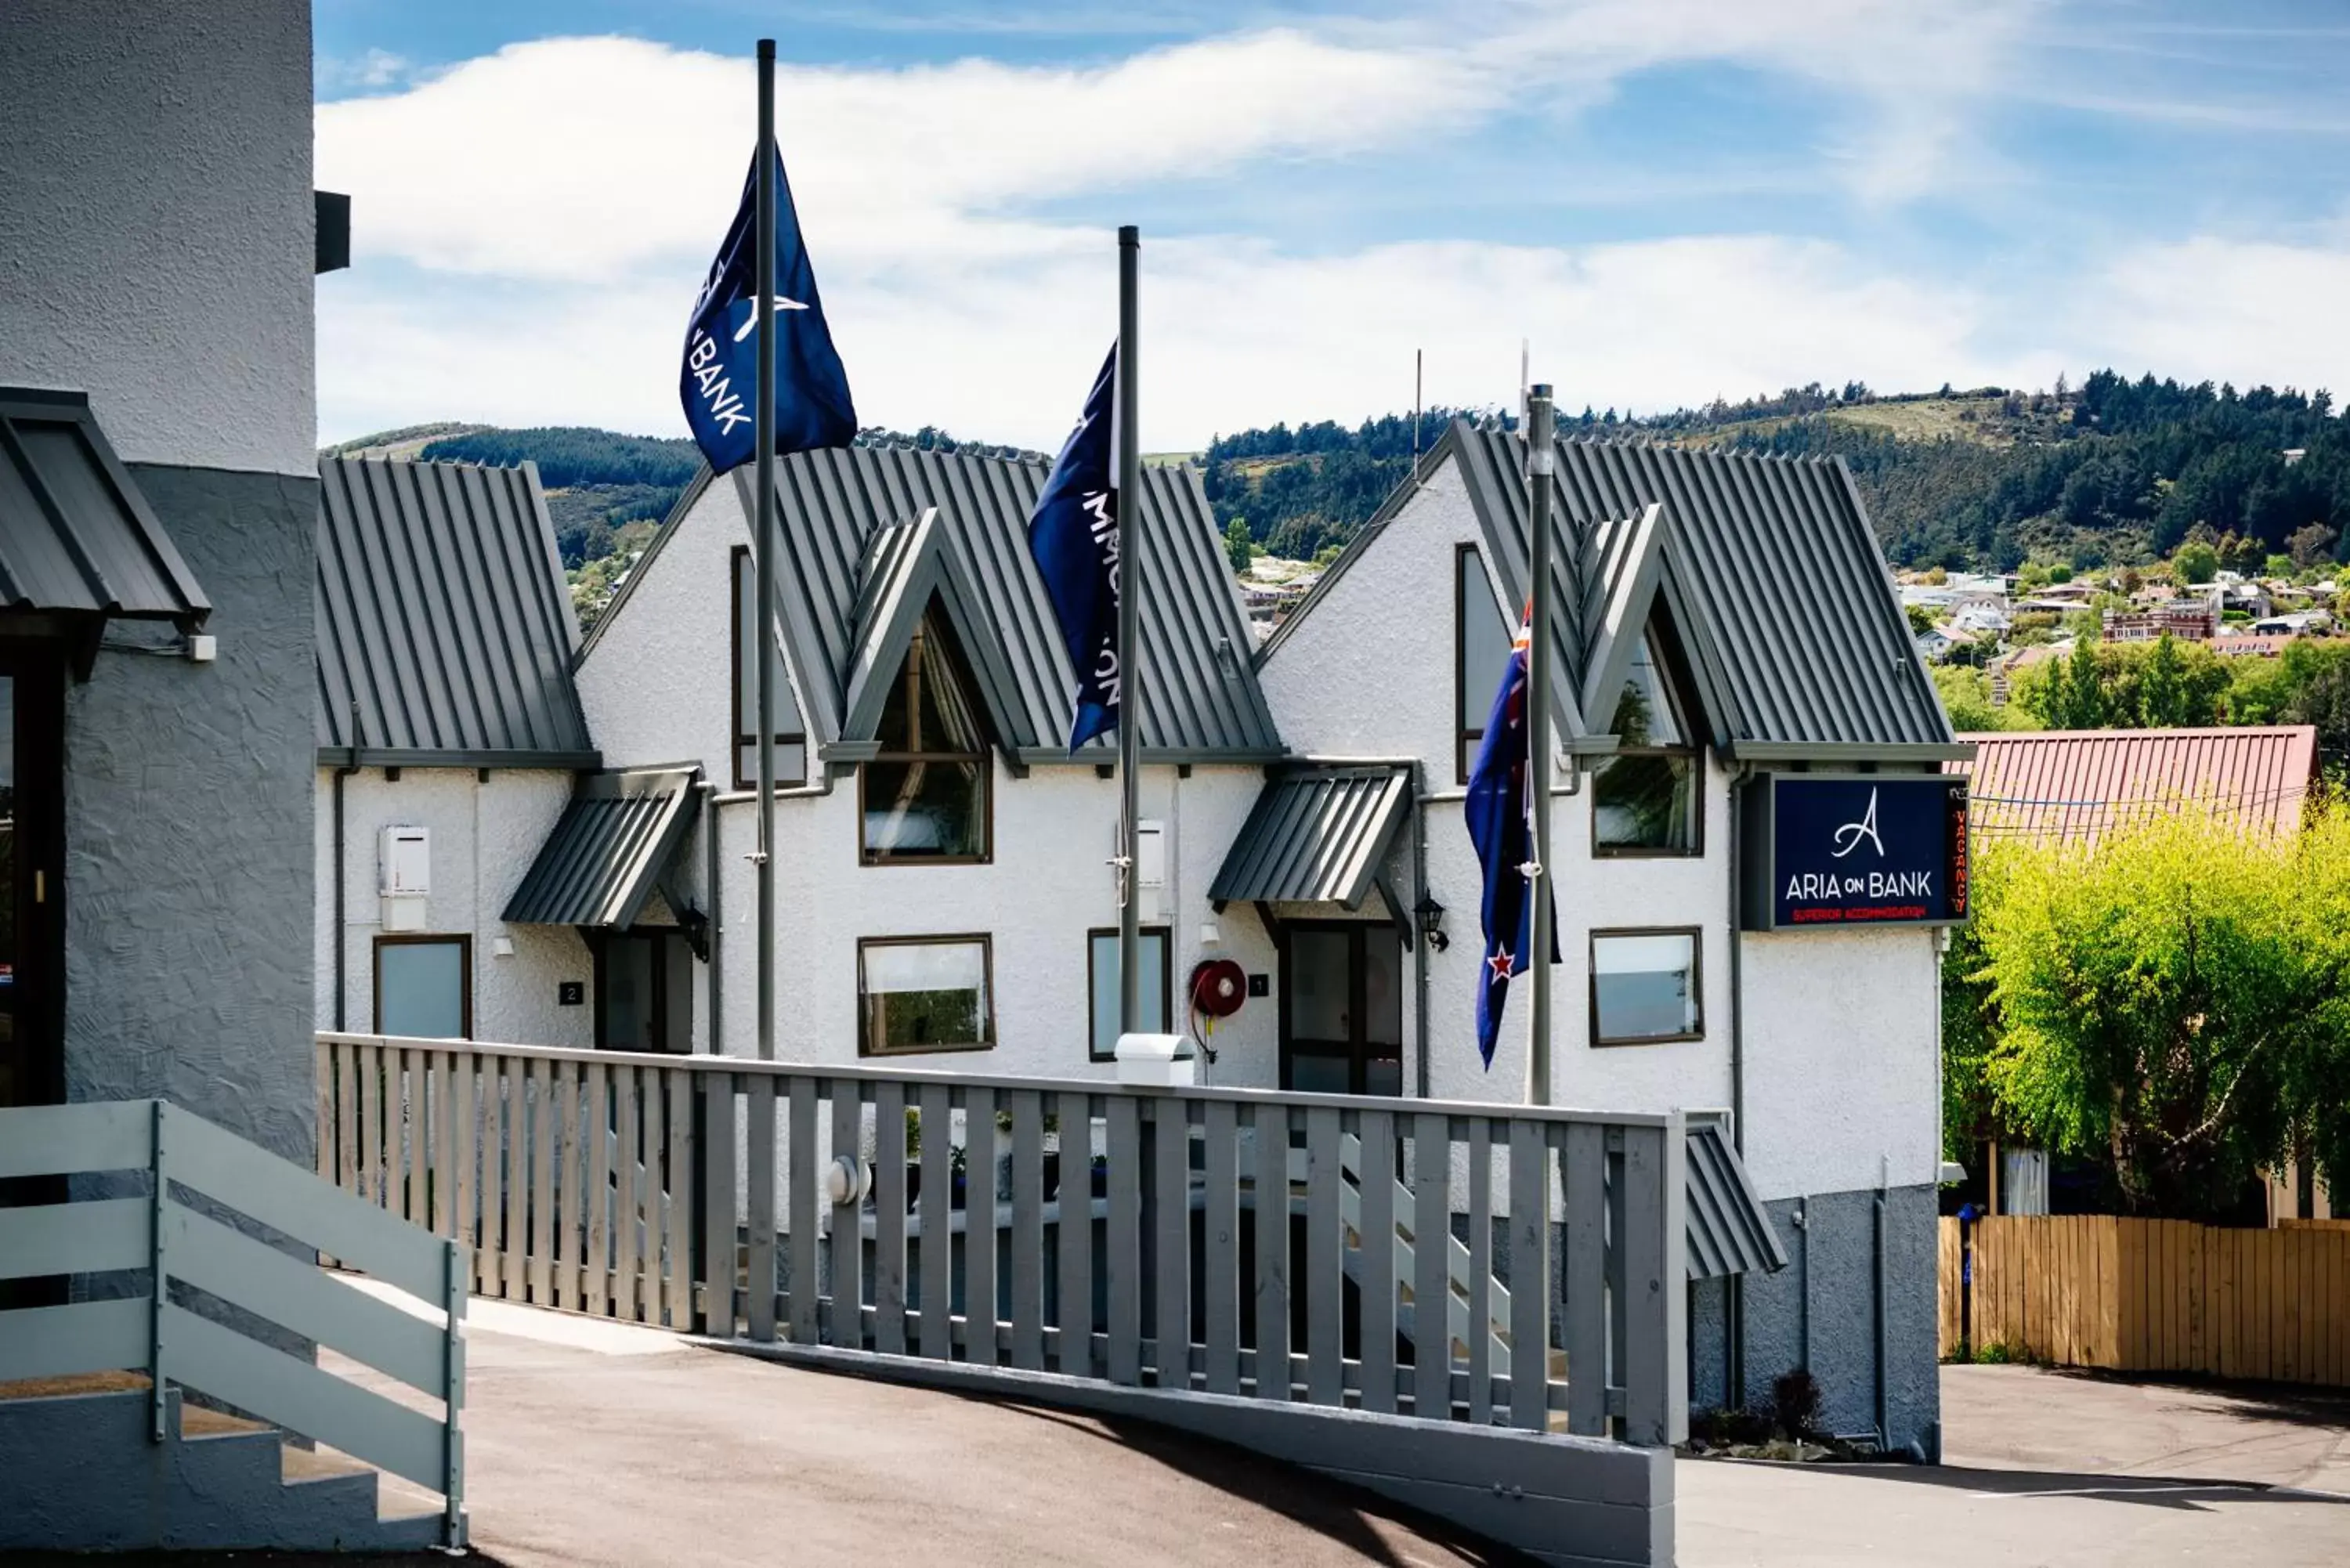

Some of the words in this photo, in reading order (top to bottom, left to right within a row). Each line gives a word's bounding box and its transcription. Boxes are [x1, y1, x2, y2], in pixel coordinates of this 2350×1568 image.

[689, 338, 752, 435] BANK
[1786, 873, 1842, 900] ARIA
[1845, 877, 1864, 894] ON
[1869, 871, 1932, 898] BANK
[1955, 811, 1966, 913] VACANCY
[567, 988, 577, 1000] 2
